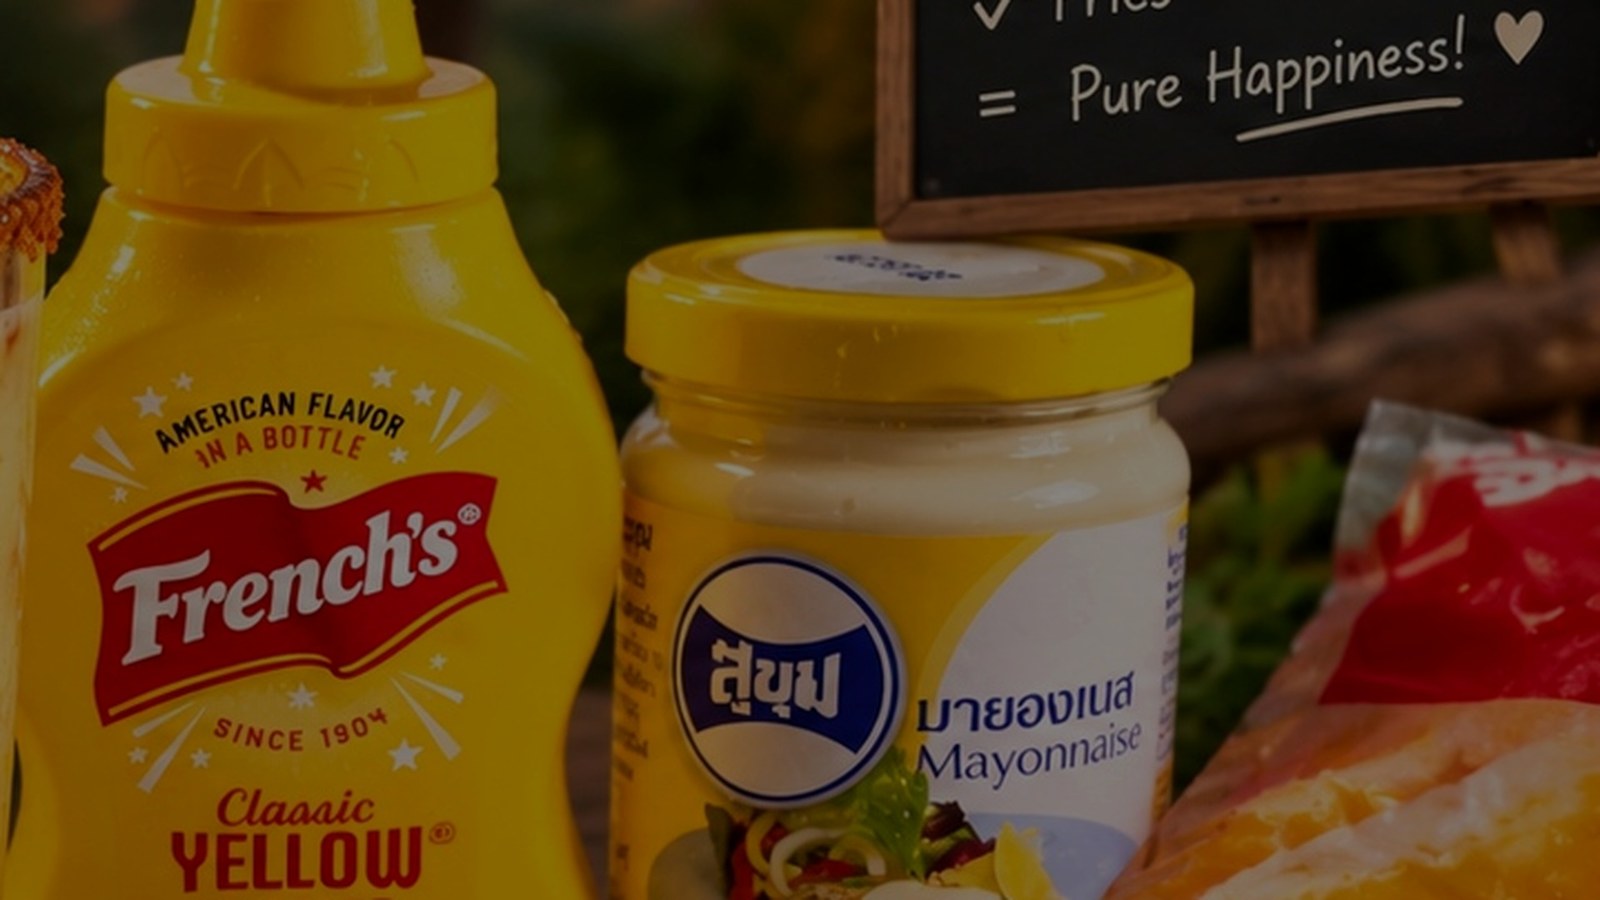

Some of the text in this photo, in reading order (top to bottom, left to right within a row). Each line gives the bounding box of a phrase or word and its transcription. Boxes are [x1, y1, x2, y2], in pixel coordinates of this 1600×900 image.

[1069, 63, 1183, 122] Pure
[1207, 14, 1466, 114] Happiness!
[155, 391, 405, 455] AMERICAN FLAVOR
[195, 424, 366, 469] IN A BOTTLE
[113, 509, 459, 667] French's
[213, 707, 389, 752] SINCE 1904
[916, 670, 1135, 732] มายองเนส
[916, 722, 1142, 791] Mayonnaise
[216, 787, 375, 827] Classic
[171, 826, 423, 893] YELLOW
